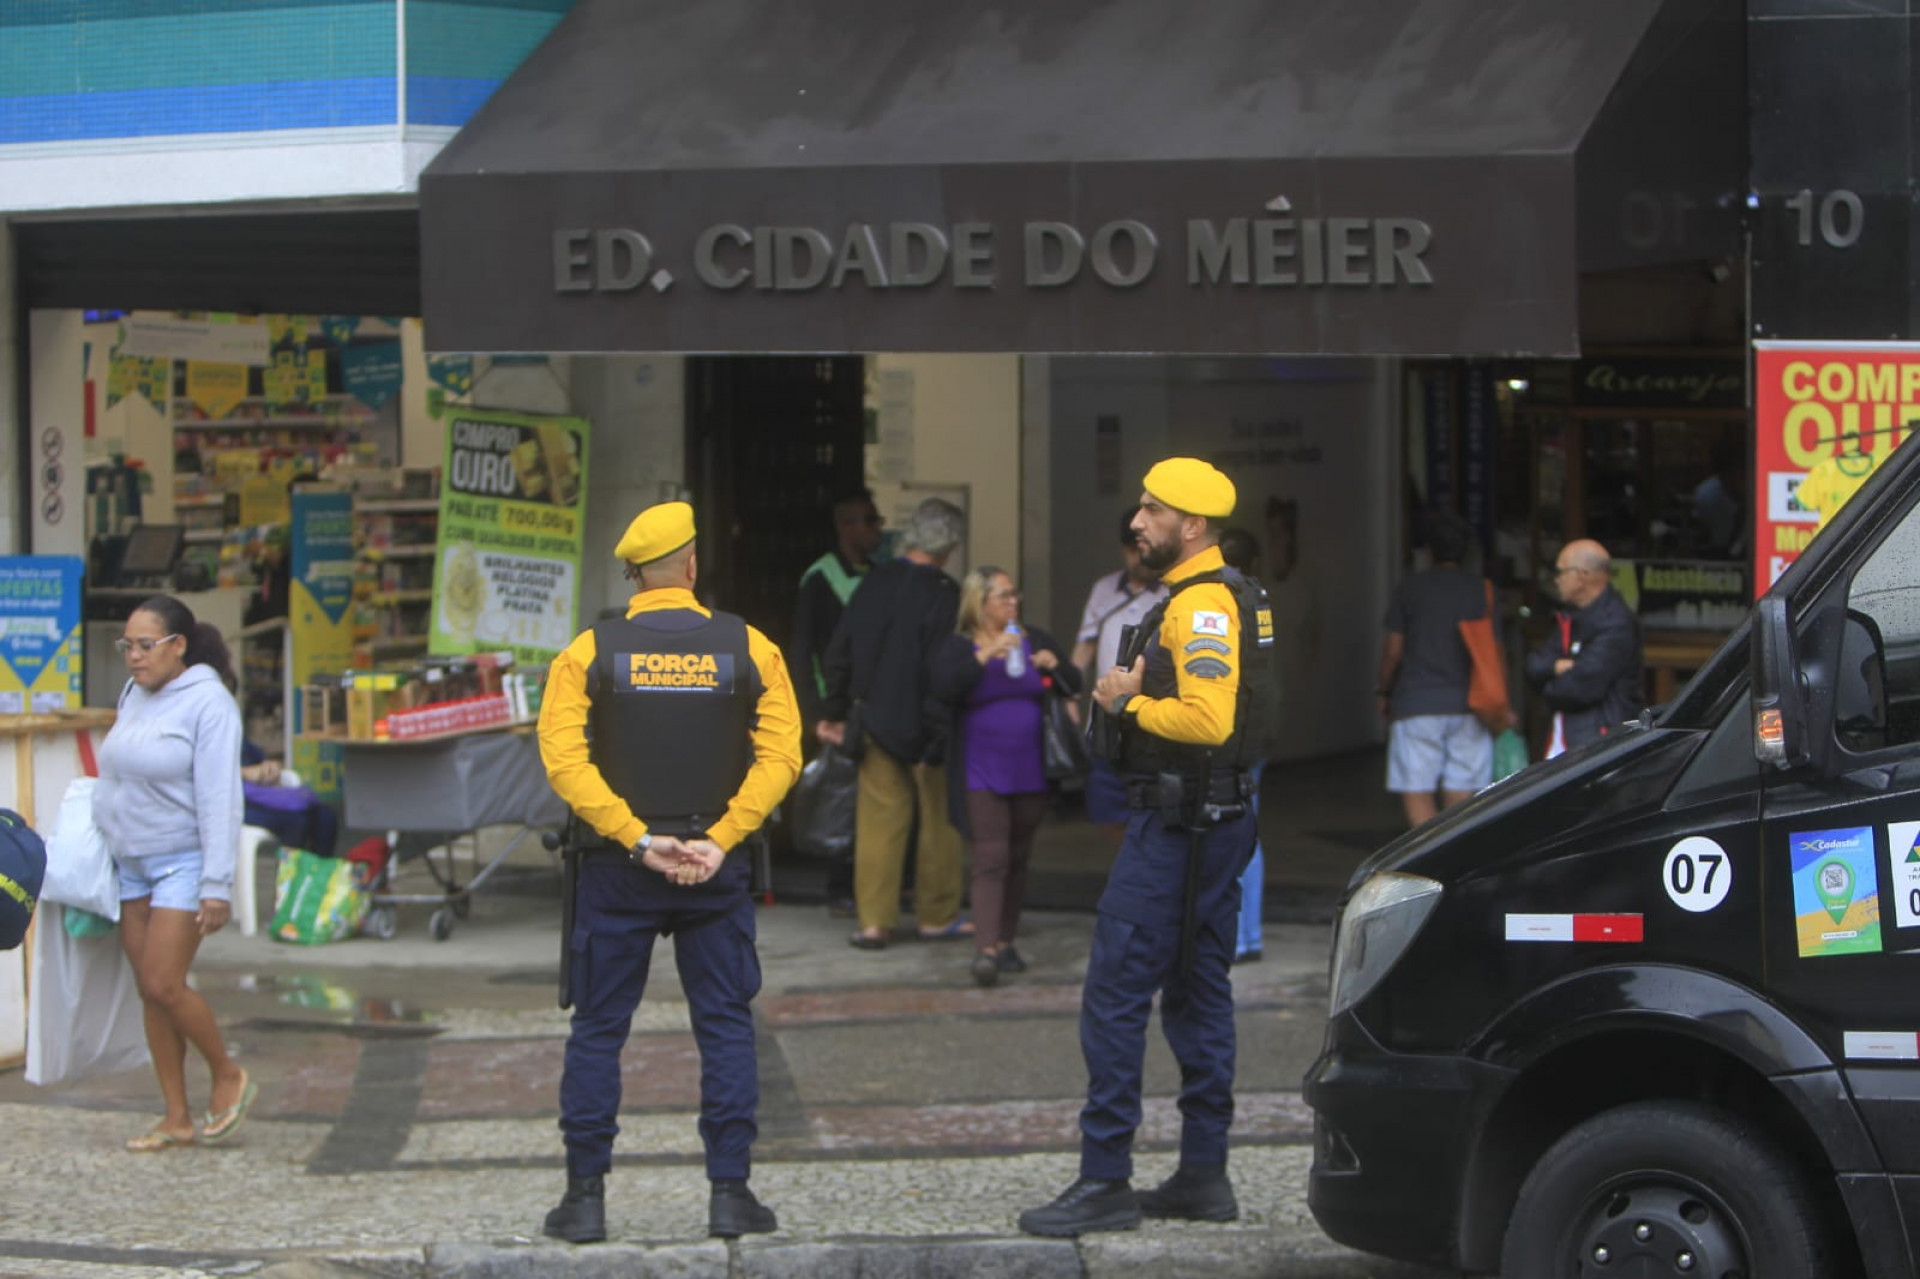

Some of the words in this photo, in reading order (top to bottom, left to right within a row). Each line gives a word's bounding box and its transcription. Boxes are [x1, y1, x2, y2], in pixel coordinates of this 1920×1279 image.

[1785, 189, 1864, 247] 10
[552, 227, 674, 293] ED.
[694, 221, 994, 290] CIDADE
[1023, 219, 1158, 287] DO
[1782, 361, 1920, 403] COMP
[630, 672, 720, 687] MUNICIPAL
[1671, 853, 1723, 895] 07
